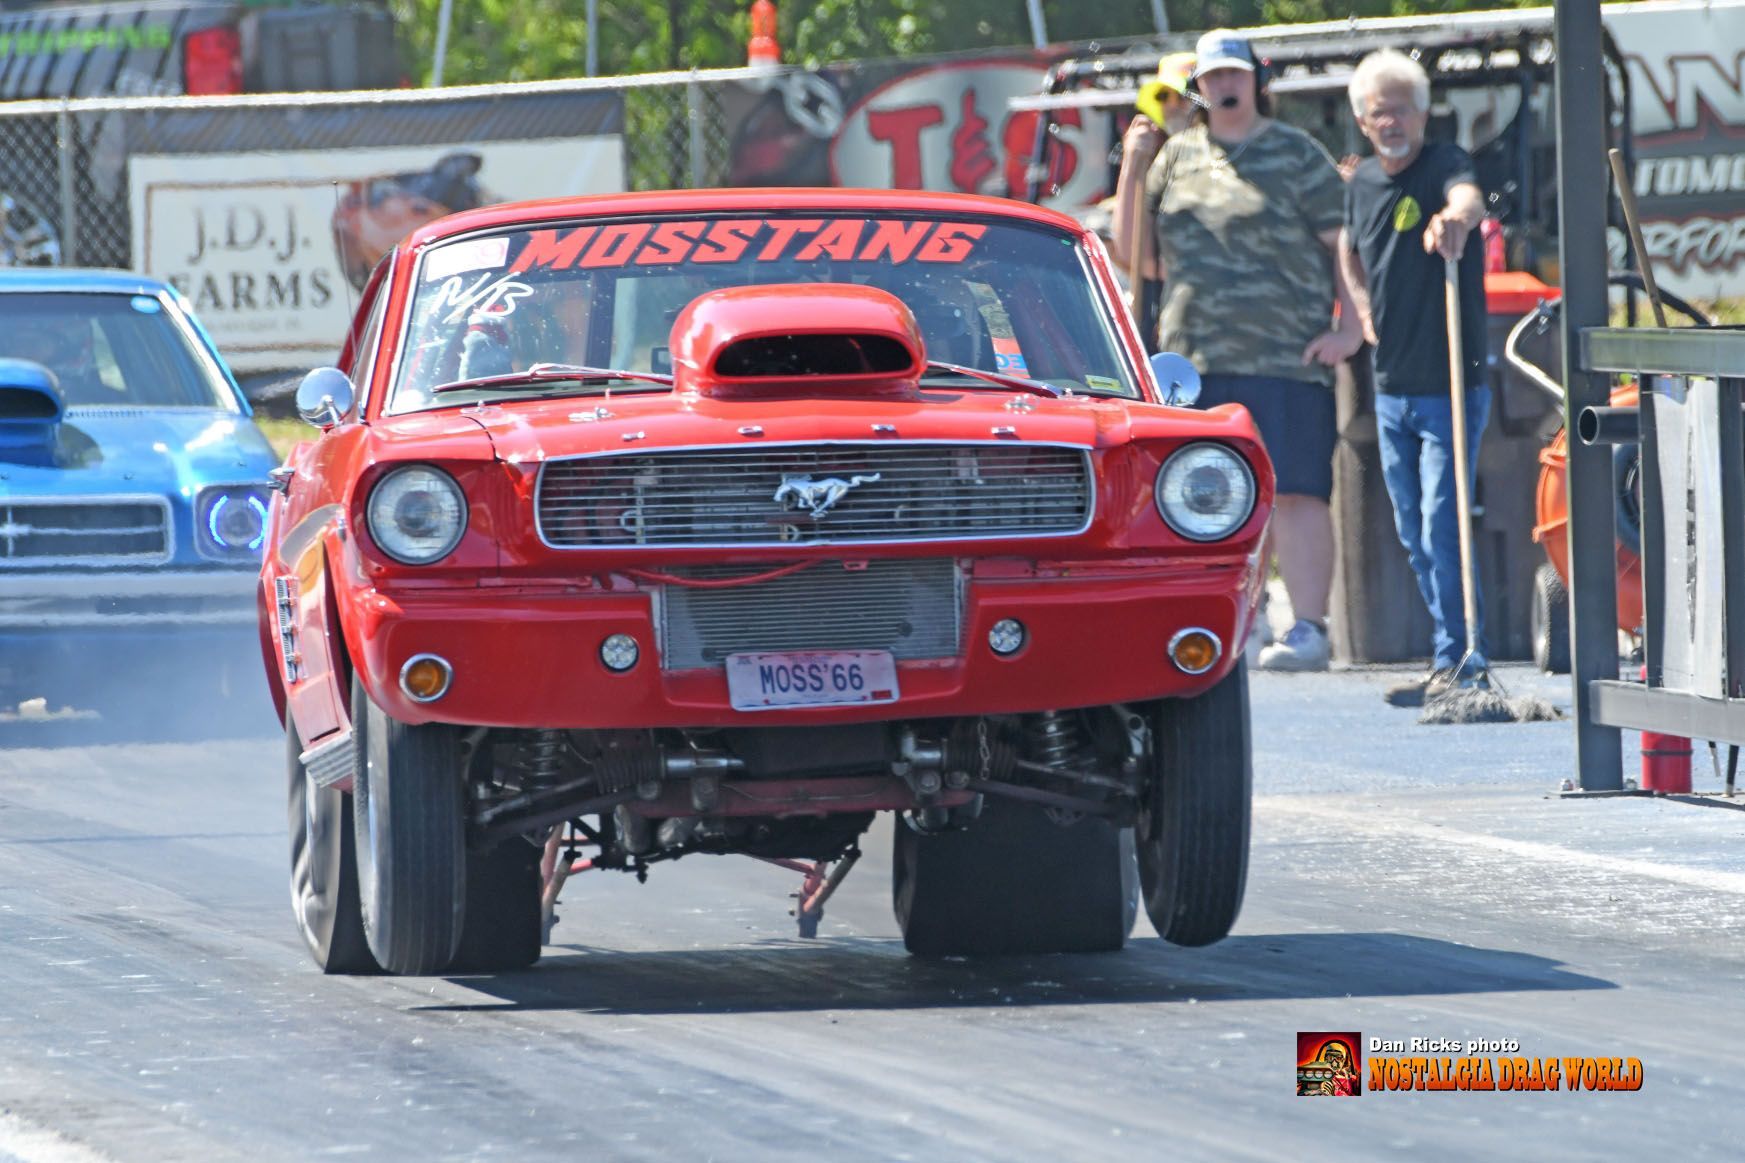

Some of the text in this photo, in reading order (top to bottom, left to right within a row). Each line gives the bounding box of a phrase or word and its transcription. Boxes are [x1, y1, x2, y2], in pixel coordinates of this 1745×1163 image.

[186, 206, 311, 265] J.D.J.
[508, 219, 988, 274] MOSSTANG
[759, 663, 864, 695] MOSS'66
